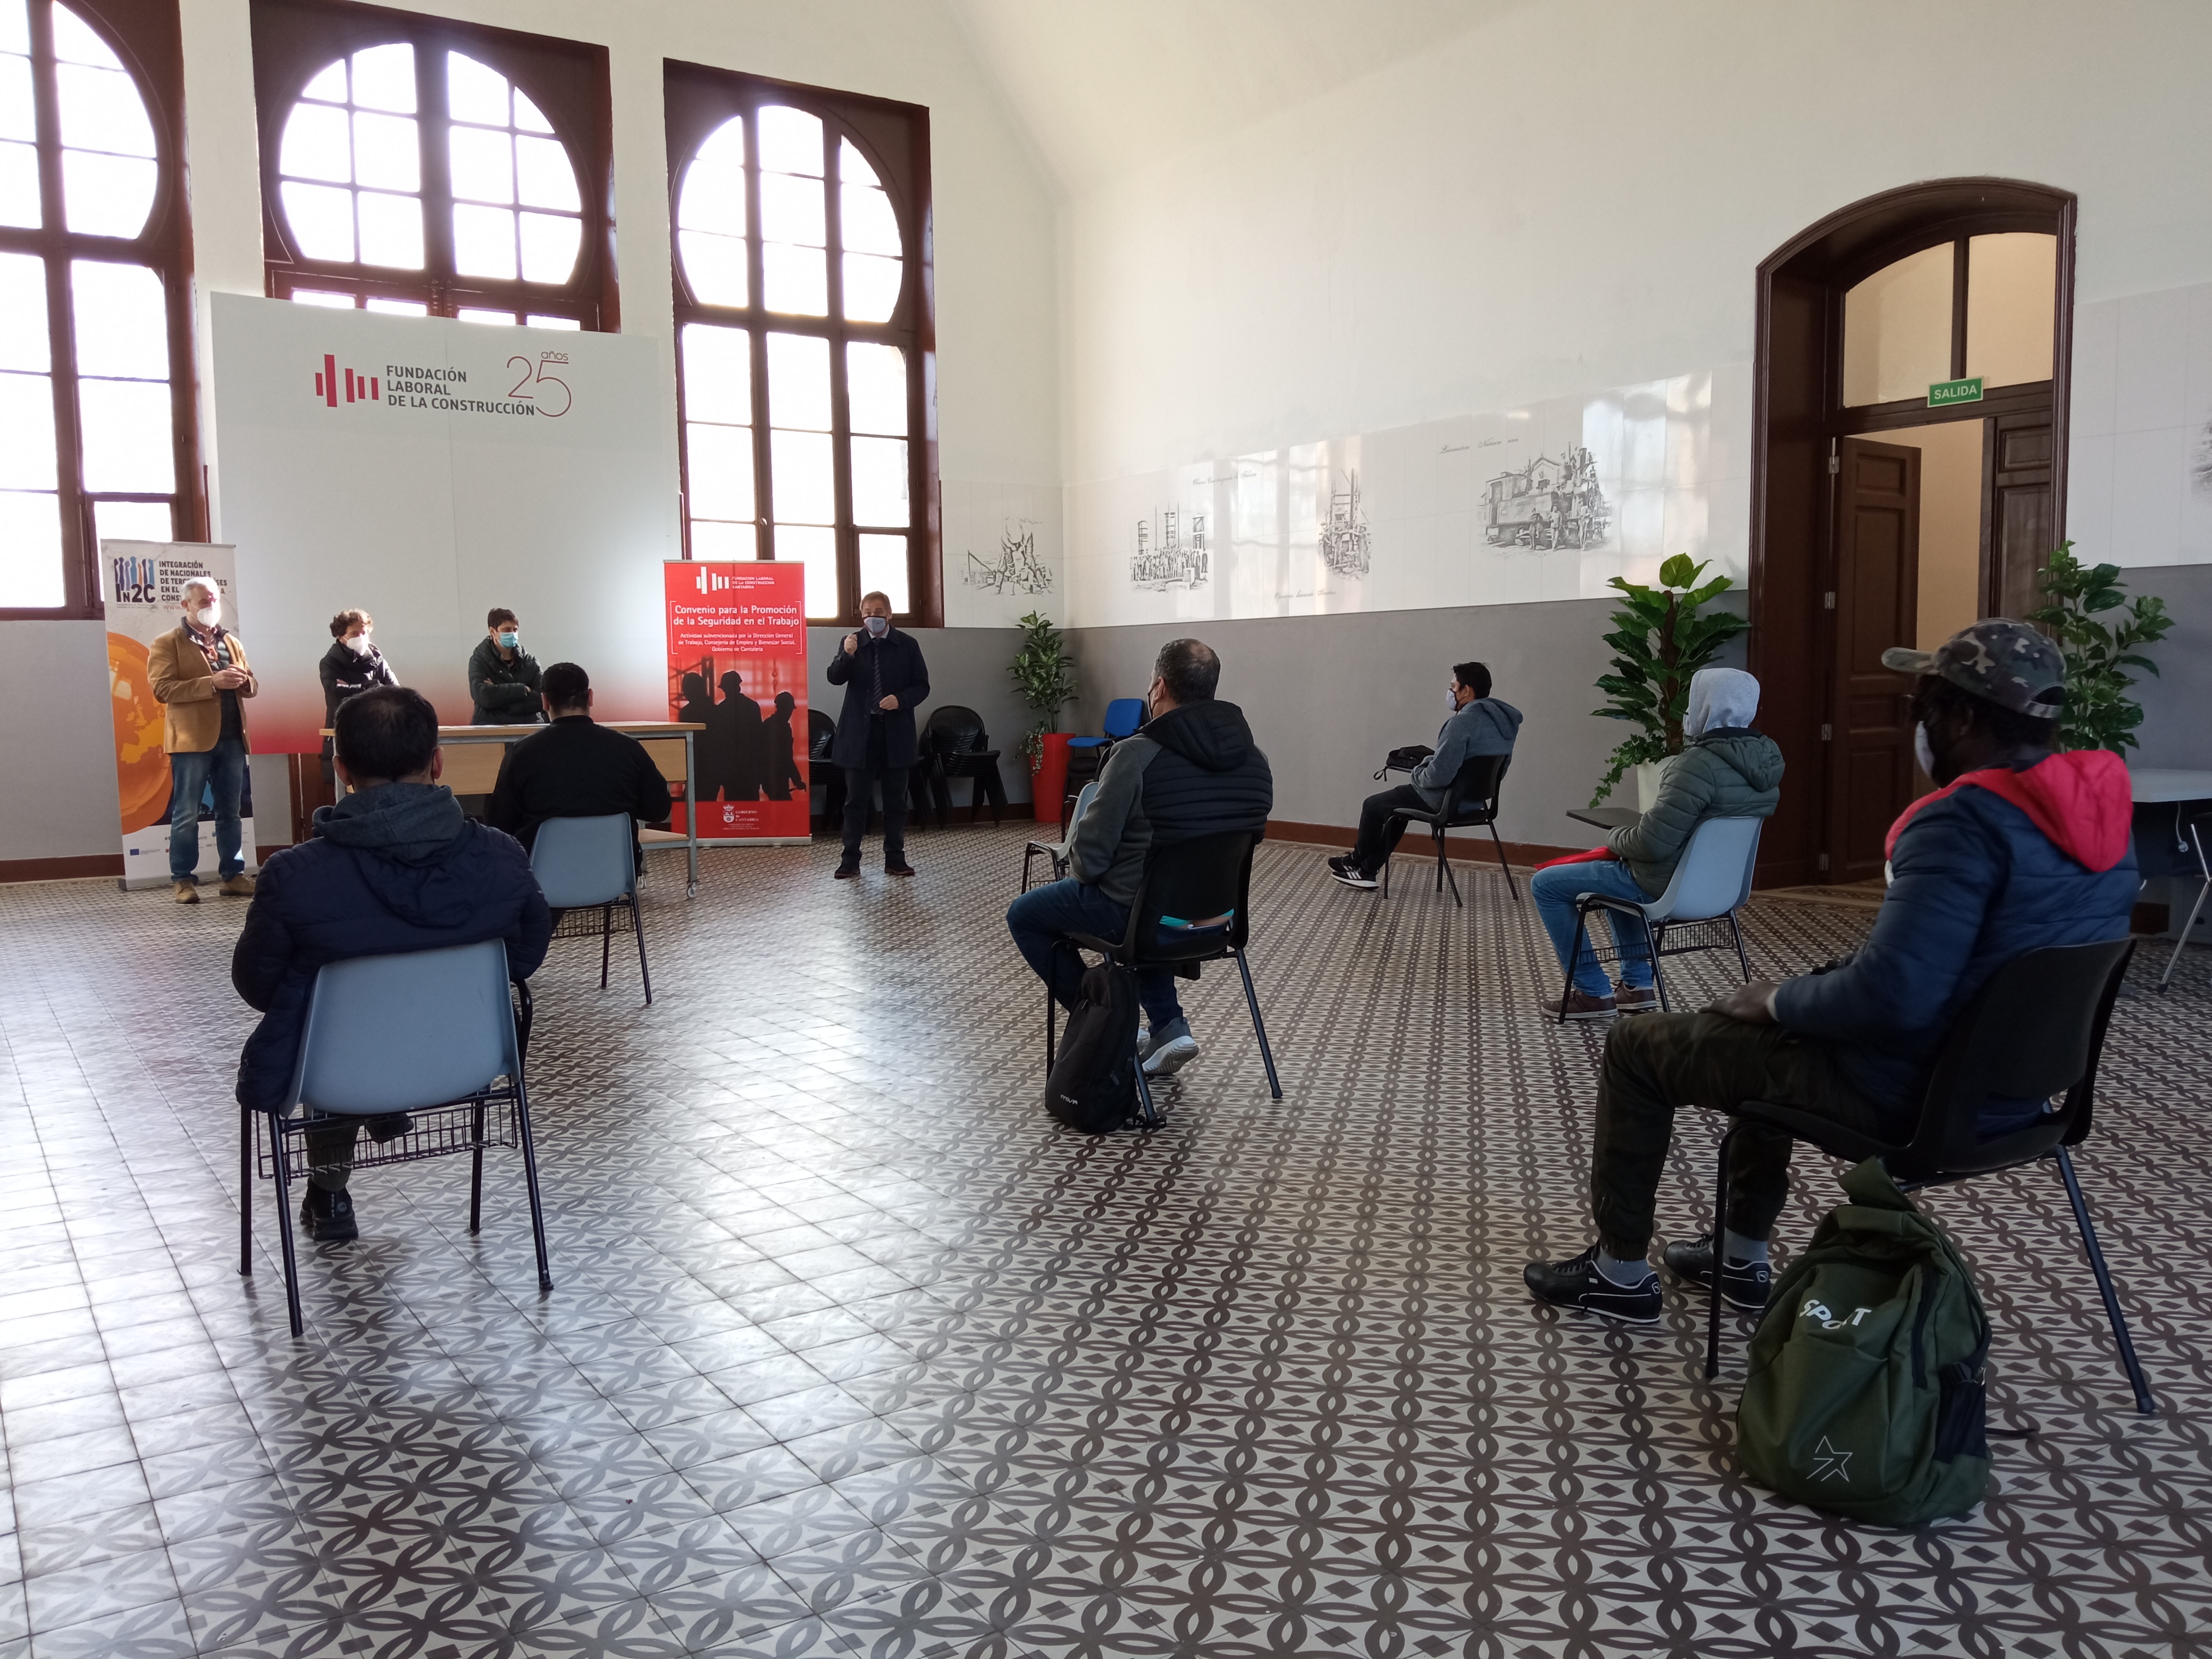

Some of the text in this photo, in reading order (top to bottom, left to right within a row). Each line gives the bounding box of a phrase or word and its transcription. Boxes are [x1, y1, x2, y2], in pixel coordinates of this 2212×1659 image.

[541, 351, 568, 361] años
[387, 365, 467, 382] FUNDACIÓN
[387, 380, 451, 396] LABORAL
[507, 356, 572, 417] 25
[1934, 385, 1977, 399] SALIDA
[388, 395, 535, 416] DE LA CONSTRUCCIÓN
[675, 605, 797, 616] Convenio para la Promoción
[673, 616, 684, 625] de
[687, 616, 695, 625] la
[698, 616, 741, 627] Seguridad
[757, 616, 765, 625] el
[767, 616, 799, 627] Trabajo
[1799, 1299, 1872, 1329] SPOT
